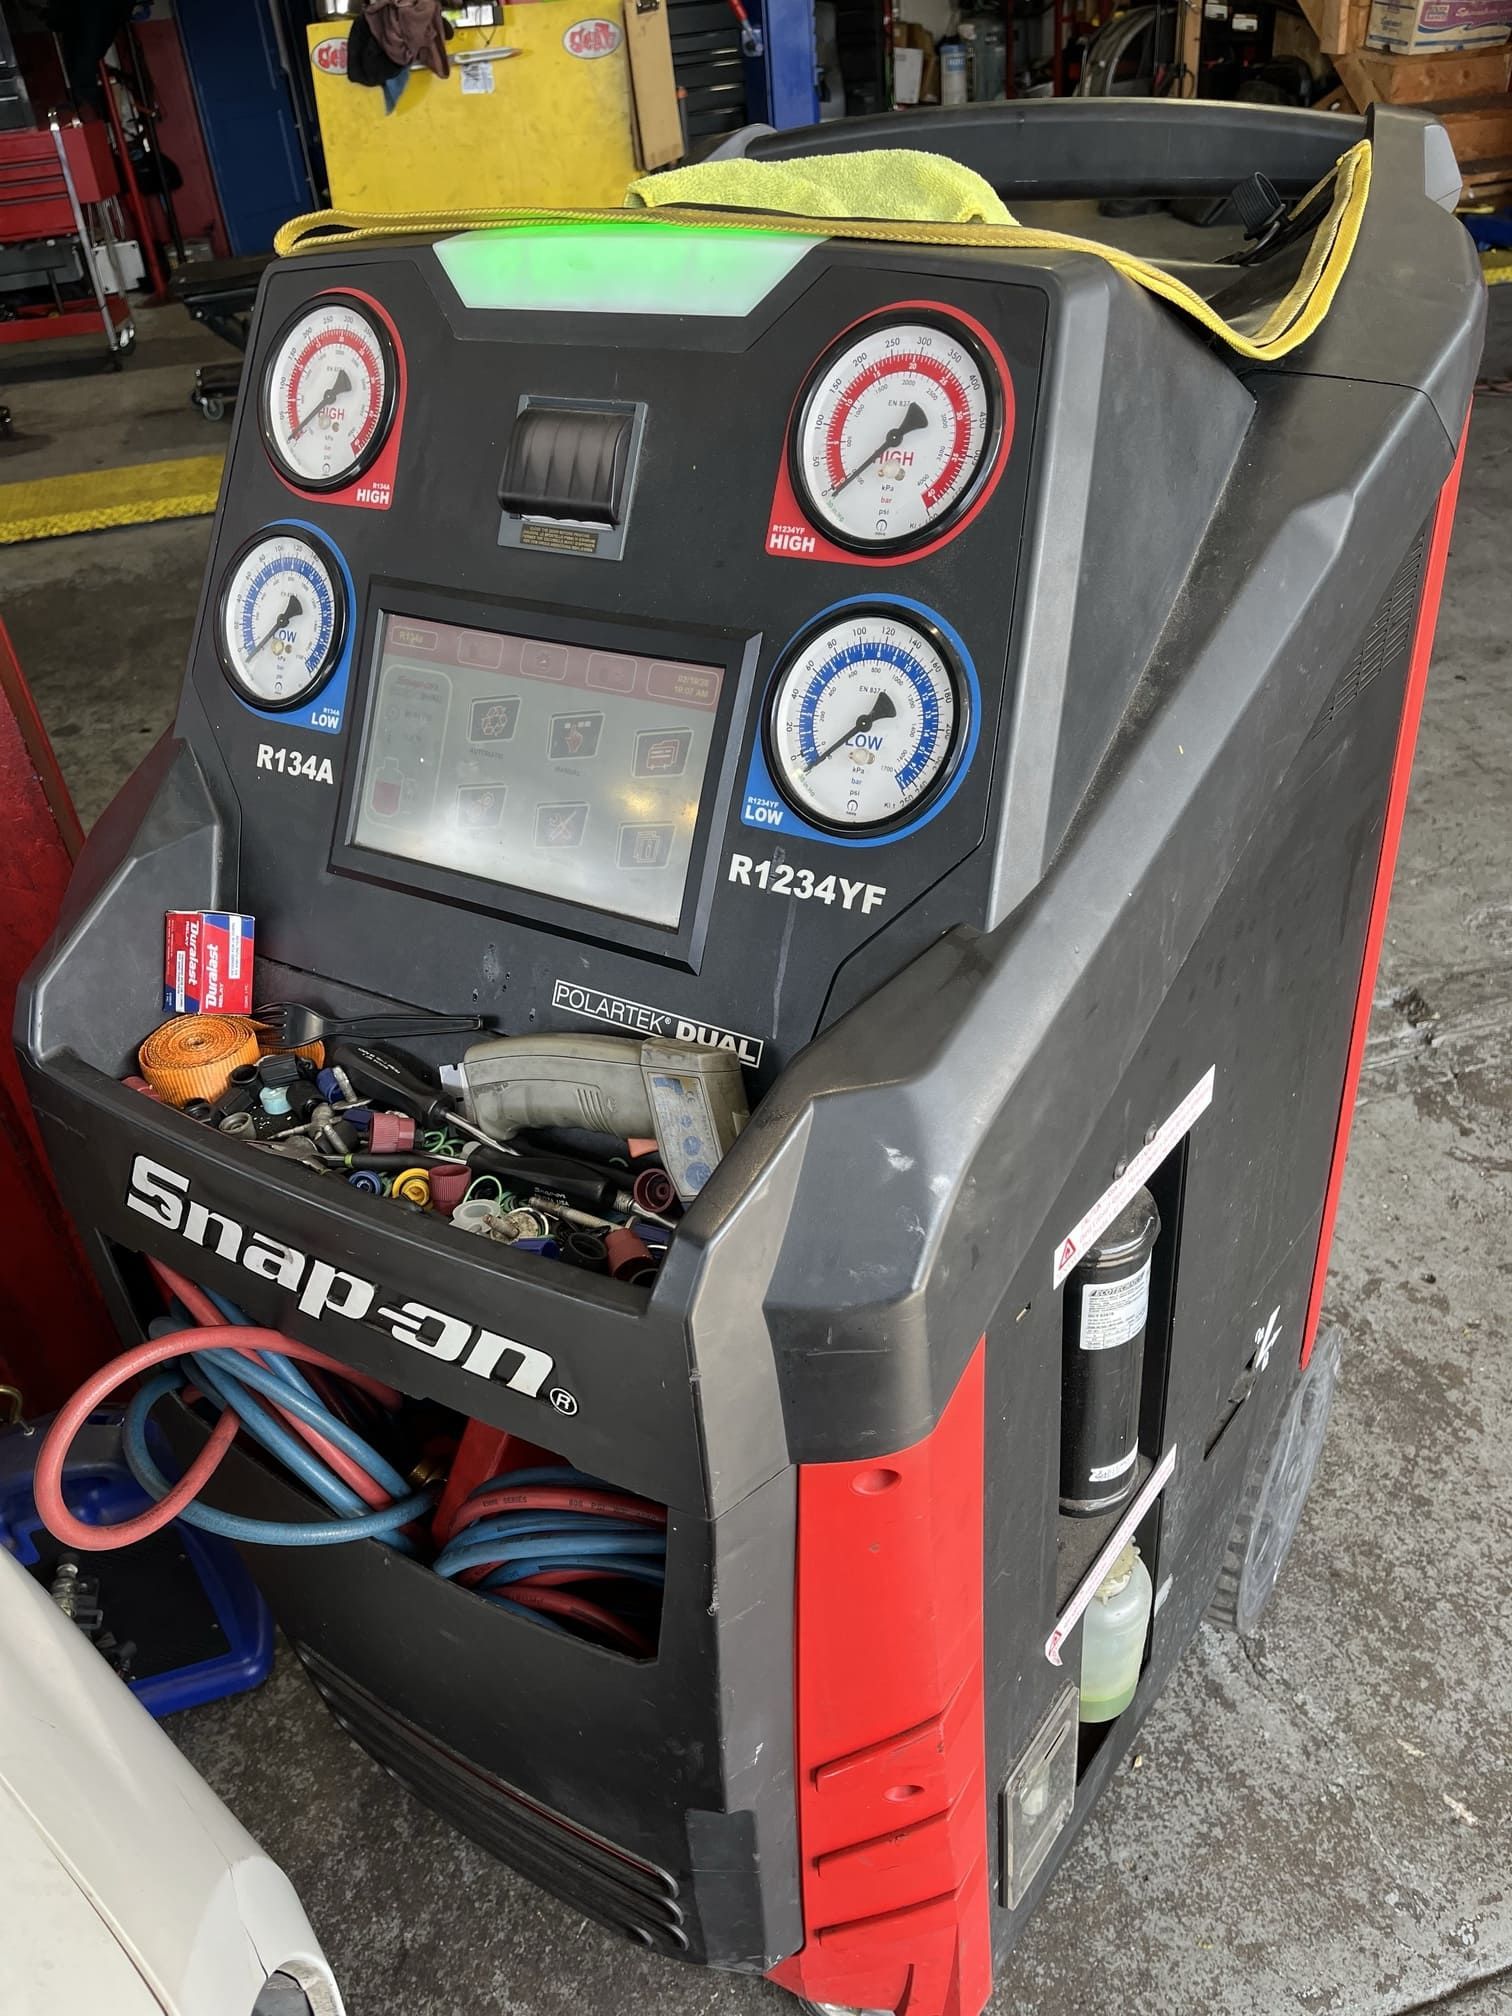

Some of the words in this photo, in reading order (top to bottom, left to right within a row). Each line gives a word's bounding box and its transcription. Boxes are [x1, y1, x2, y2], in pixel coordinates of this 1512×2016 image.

[885, 337, 900, 348] 250
[916, 337, 932, 346] 300
[852, 352, 868, 368] 200
[947, 348, 962, 364] 350
[829, 378, 842, 394] 150
[969, 373, 981, 391] 400
[319, 407, 345, 421] HIGH
[814, 414, 825, 431] 100
[812, 456, 820, 468] 50
[873, 450, 914, 467] HIGH
[356, 488, 390, 505] HIGH
[773, 525, 805, 534] R1234YF
[770, 534, 816, 553] HIGH
[852, 627, 867, 636] 100
[881, 627, 896, 636] 120
[827, 638, 837, 649] 80
[908, 637, 922, 650] 140
[806, 660, 816, 671] 60
[929, 657, 942, 673] 160
[791, 688, 799, 700] 40
[943, 687, 952, 704] 180
[311, 712, 340, 729] LOW
[786, 721, 793, 732] 20
[844, 734, 883, 751] LOW
[257, 743, 334, 785] R134A
[851, 777, 863, 785] bar
[849, 789, 860, 797] psi
[748, 796, 779, 808] R1234YF
[744, 806, 783, 826] LOW
[728, 853, 887, 914] R1234YF
[188, 921, 200, 986] Duralast
[205, 943, 219, 1009] Duralast
[676, 1020, 756, 1063] DUAL
